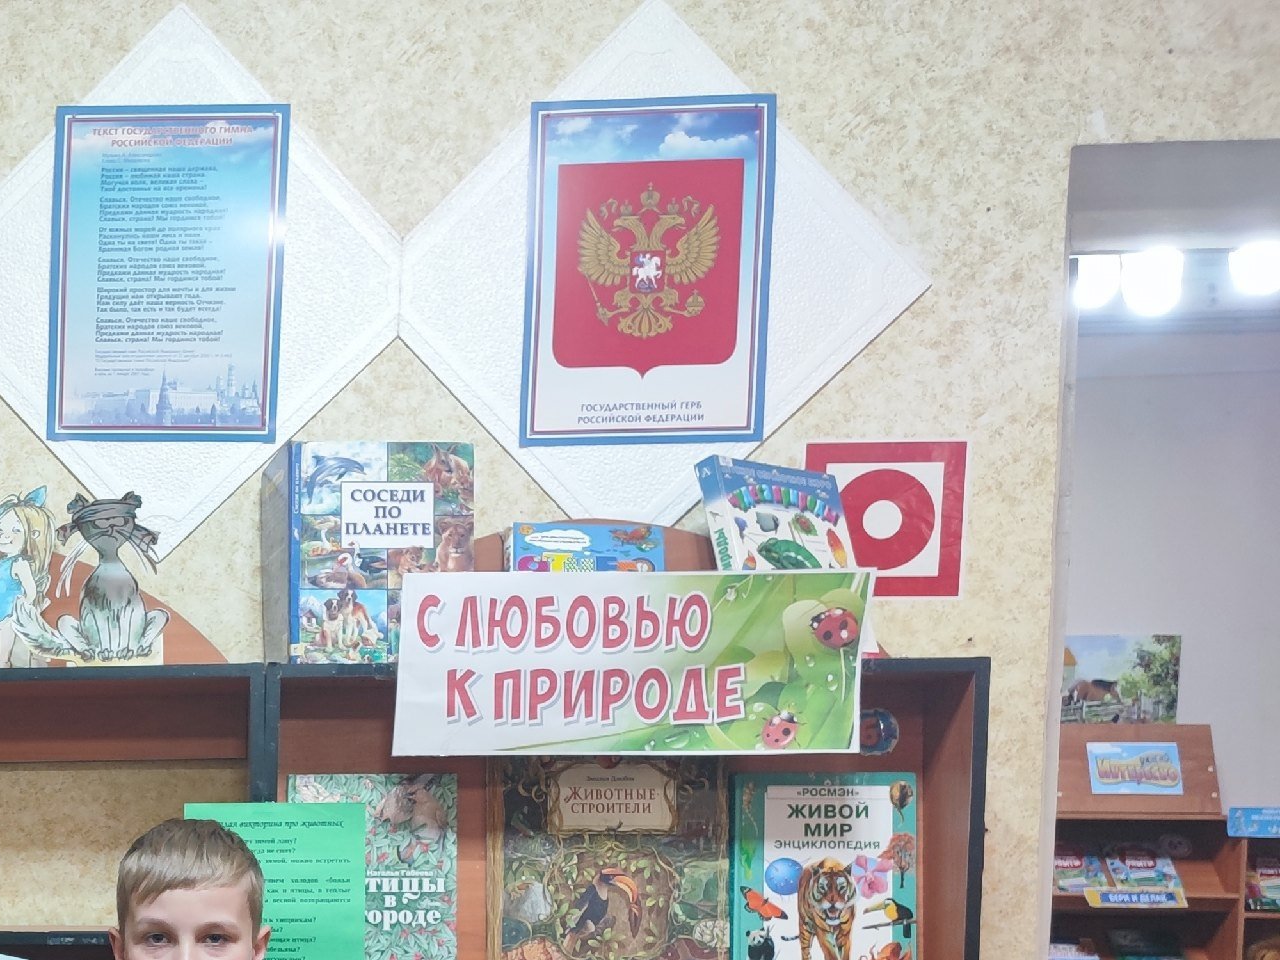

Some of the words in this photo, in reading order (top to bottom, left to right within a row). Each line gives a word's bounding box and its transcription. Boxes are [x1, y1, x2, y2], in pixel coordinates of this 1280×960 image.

[581, 401, 676, 412] ГОСУДАРСТВЕННЫЙ
[680, 401, 702, 410] ГЕРБ
[577, 413, 642, 424] РОССИЙСКОЙ
[644, 413, 704, 423] ФЕДЕРАЦИИ
[350, 489, 426, 503] СОСЕДИ
[374, 506, 401, 519] ПО
[345, 523, 431, 536] ПЛАНЕТЕ
[416, 593, 442, 649] С
[455, 592, 711, 651] ЛЮБОВЬЮ
[445, 667, 477, 720] К
[493, 663, 748, 721] ПРИРОДЕ
[570, 802, 651, 814] СТРОИТЕЛИ
[786, 801, 869, 819] ЖИВОЙ
[804, 823, 853, 837] МИР
[774, 839, 881, 850] ЭНЦИКЛОПЕДИЯ
[365, 878, 445, 904] тицы
[383, 895, 397, 908] в
